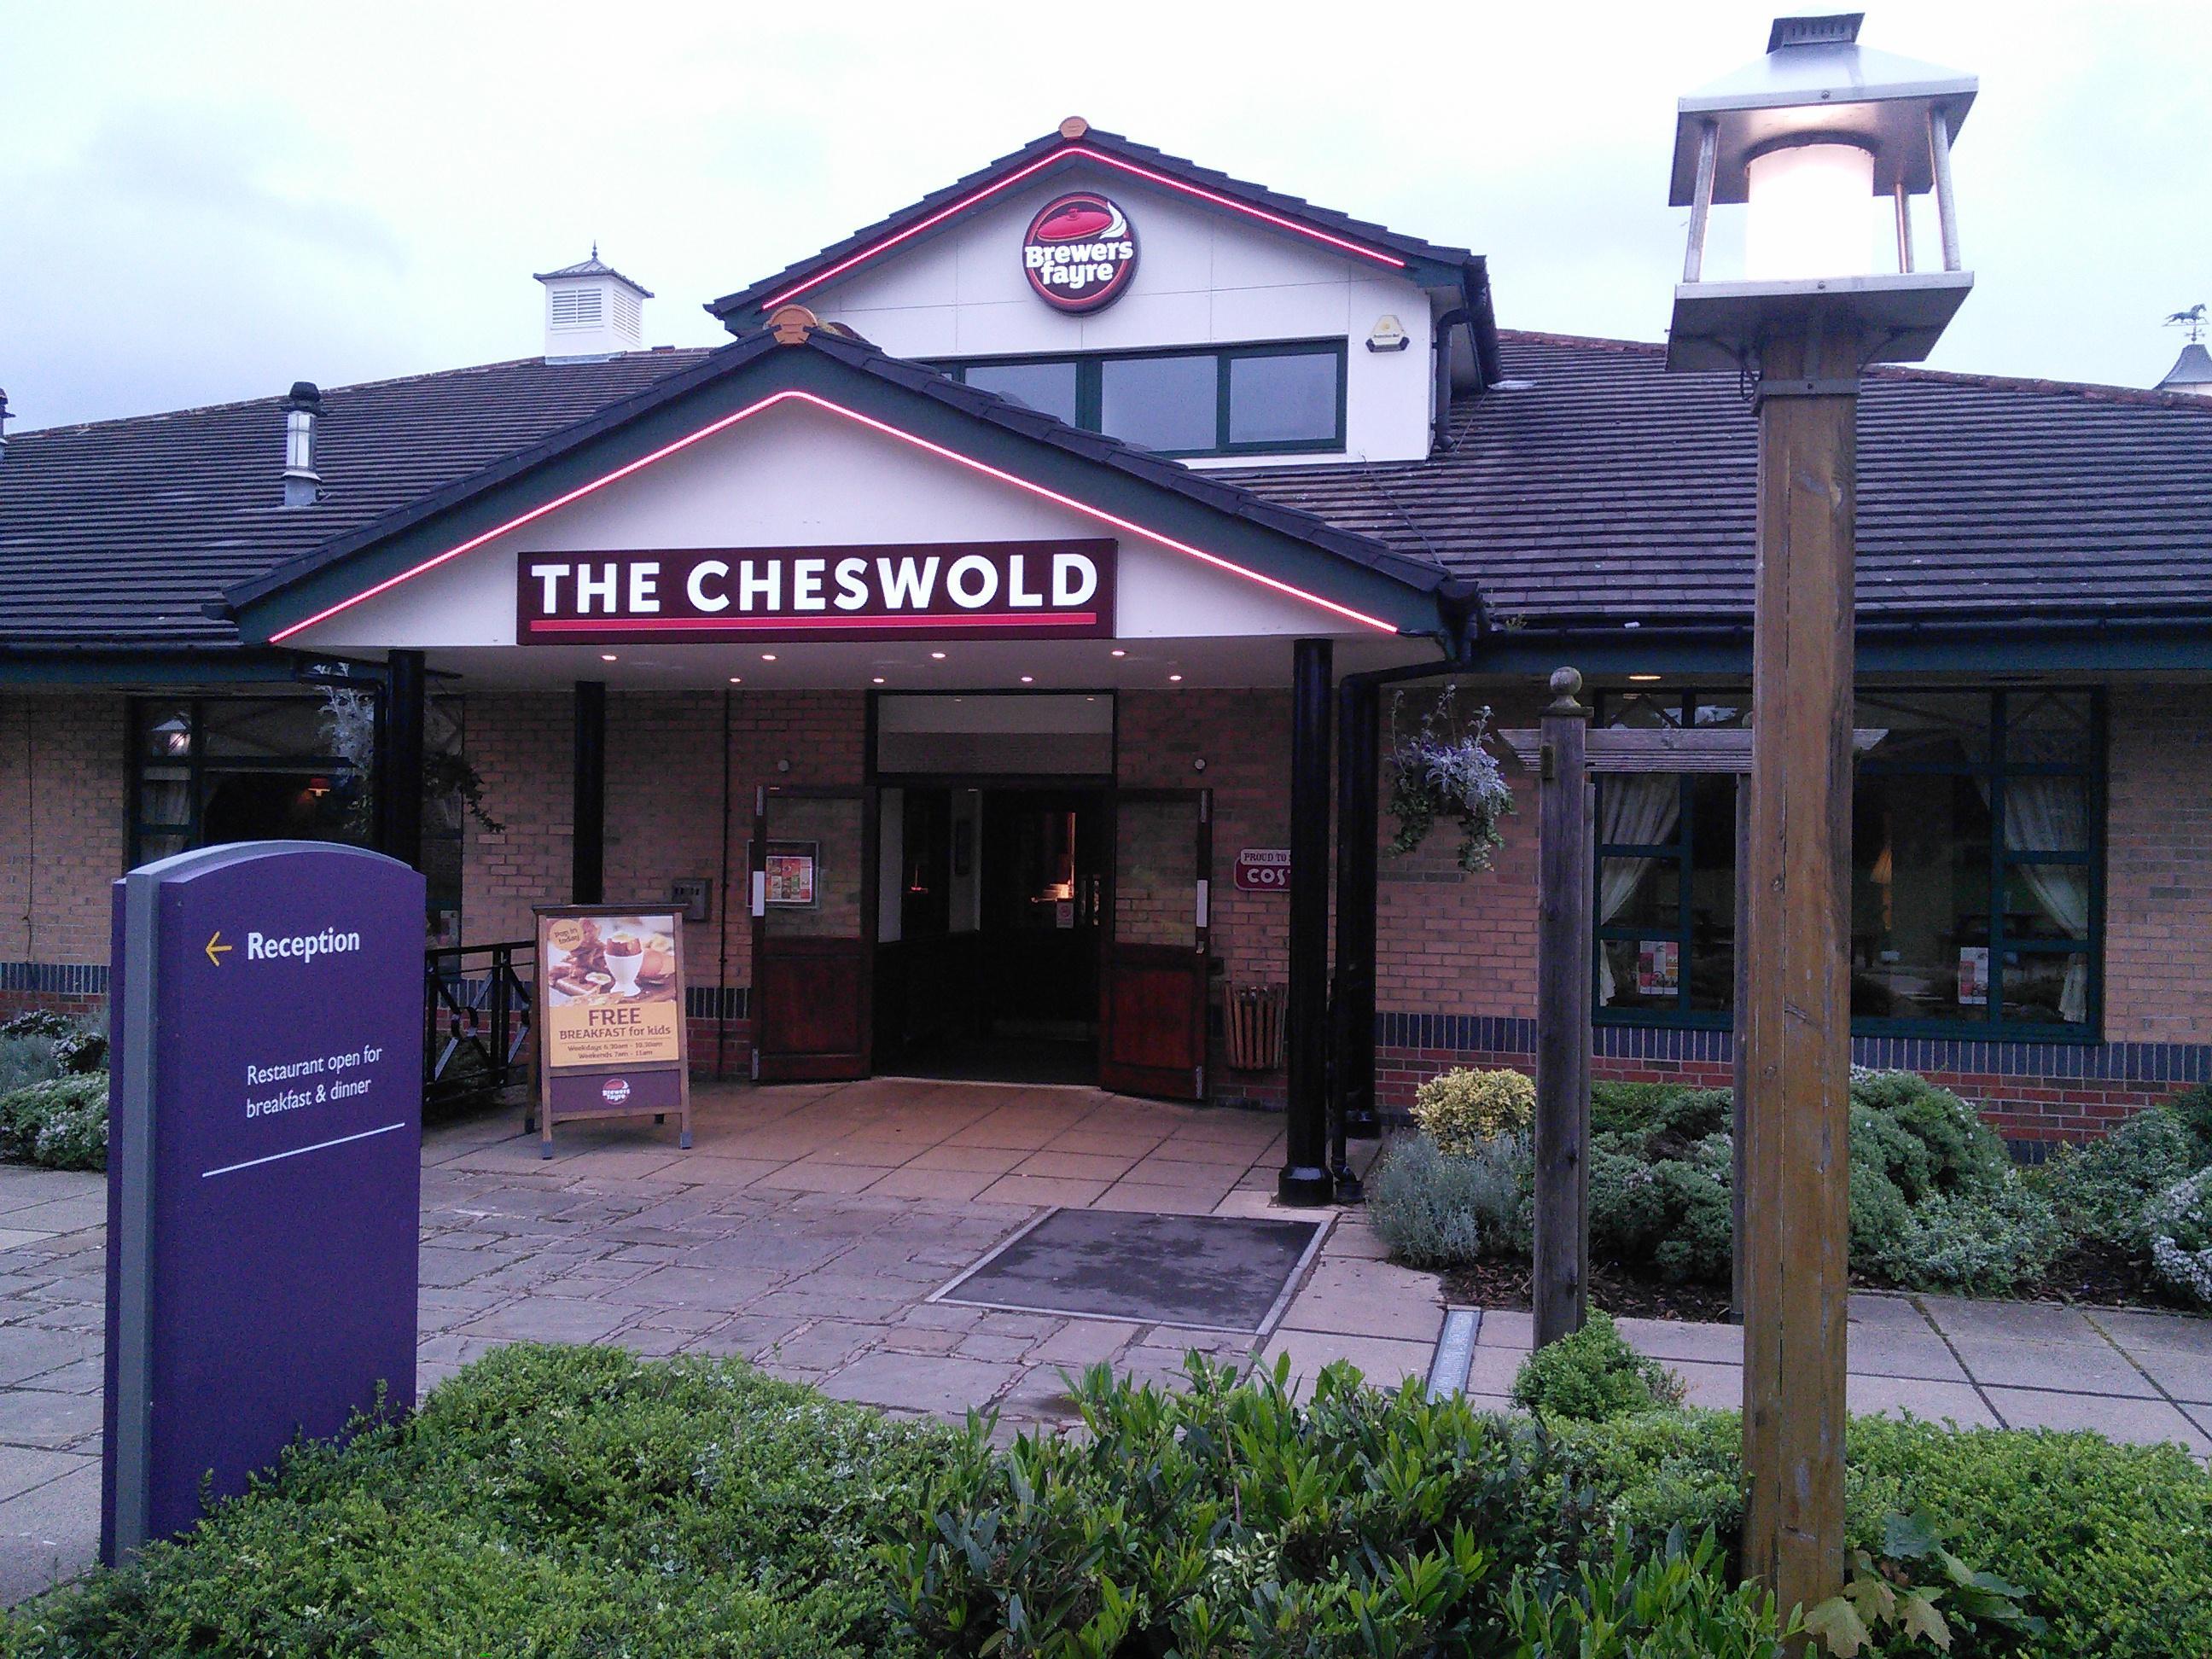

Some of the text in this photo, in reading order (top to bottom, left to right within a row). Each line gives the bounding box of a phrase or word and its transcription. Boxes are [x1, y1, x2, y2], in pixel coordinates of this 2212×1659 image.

[1025, 241, 1133, 268] Brewers
[1040, 260, 1114, 288] fayre
[531, 553, 1097, 614] THE CHESWOLD
[1243, 853, 1273, 862] PROUD
[1276, 853, 1286, 862] TO
[1247, 868, 1290, 886] COS
[247, 927, 360, 963] Reception
[588, 1007, 642, 1027] FREE
[559, 1024, 672, 1040] BREAKFAST for kids
[568, 1044, 602, 1052] Weekdays
[247, 1045, 383, 1086] Restaurant open for
[246, 1078, 371, 1119] breakfast & dinner
